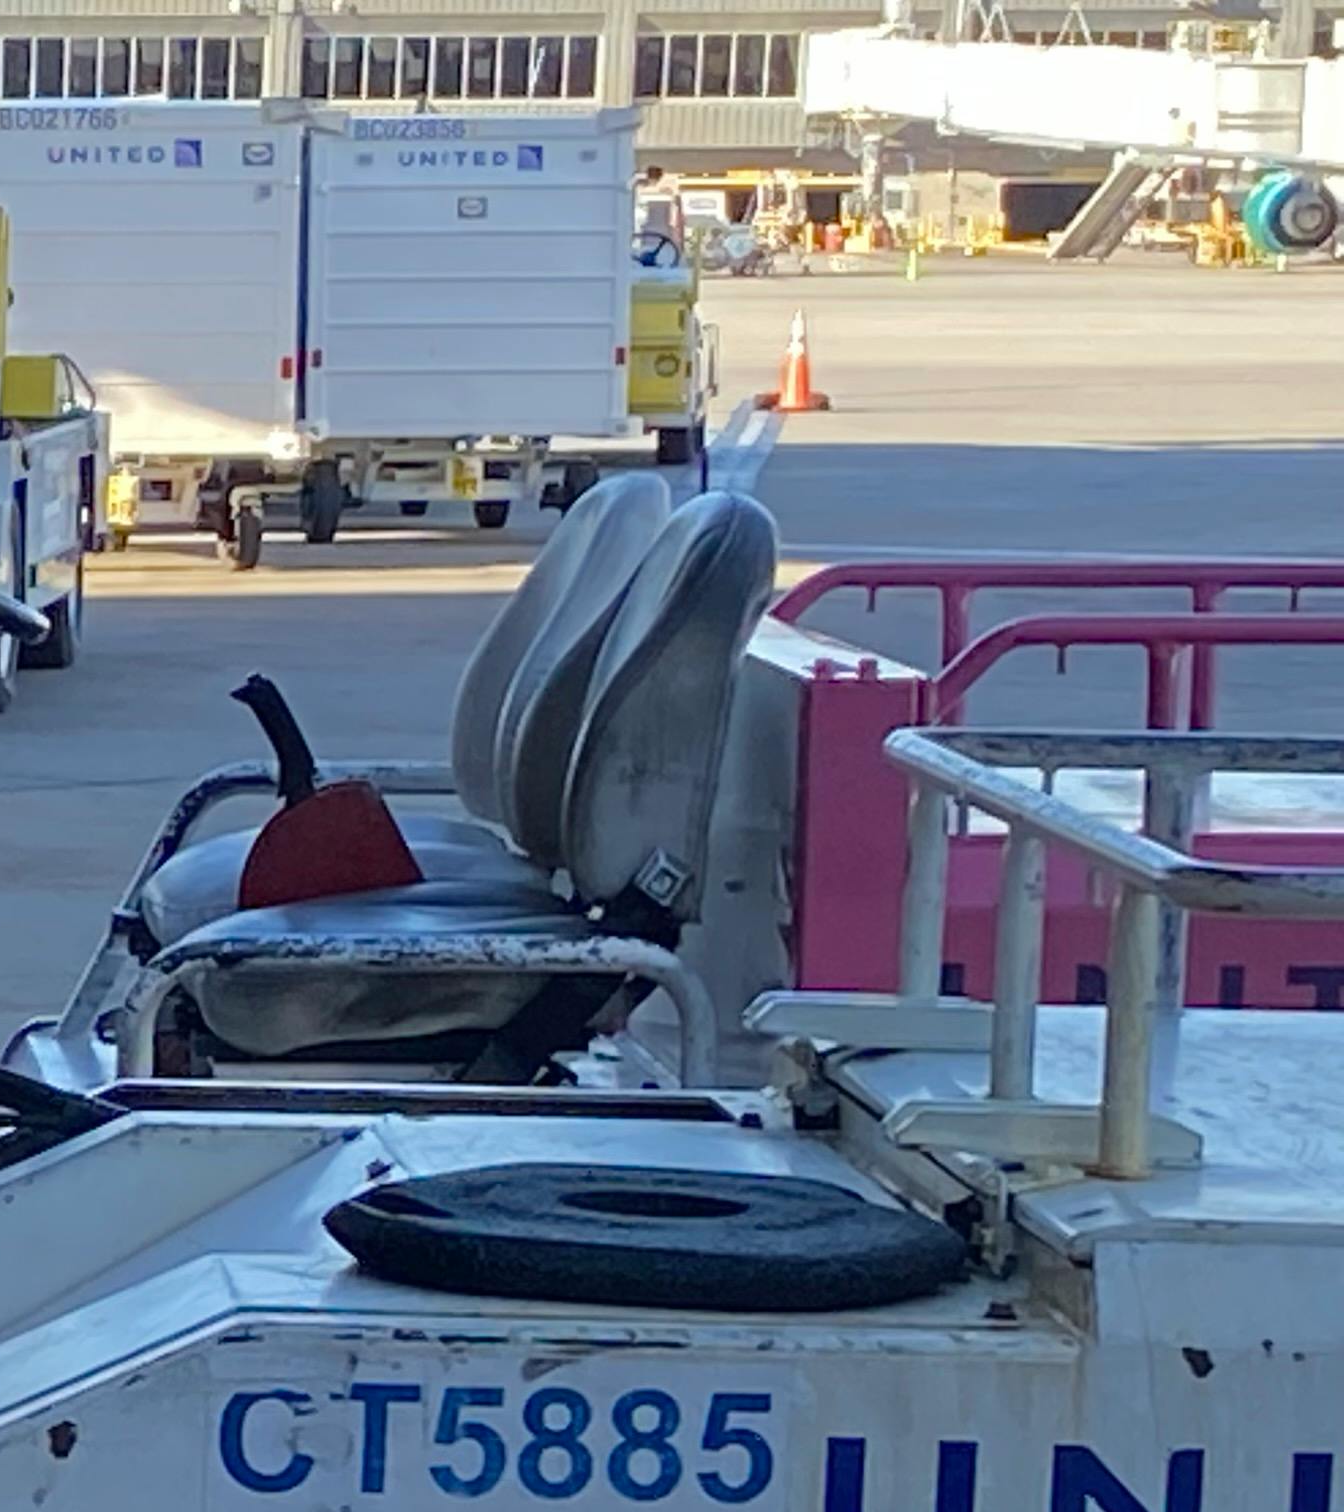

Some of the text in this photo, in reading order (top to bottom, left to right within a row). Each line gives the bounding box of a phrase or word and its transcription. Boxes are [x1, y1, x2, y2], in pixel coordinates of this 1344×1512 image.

[47, 145, 166, 164] UNITED
[398, 150, 509, 167] UNITED
[219, 1382, 774, 1504] CT5885
